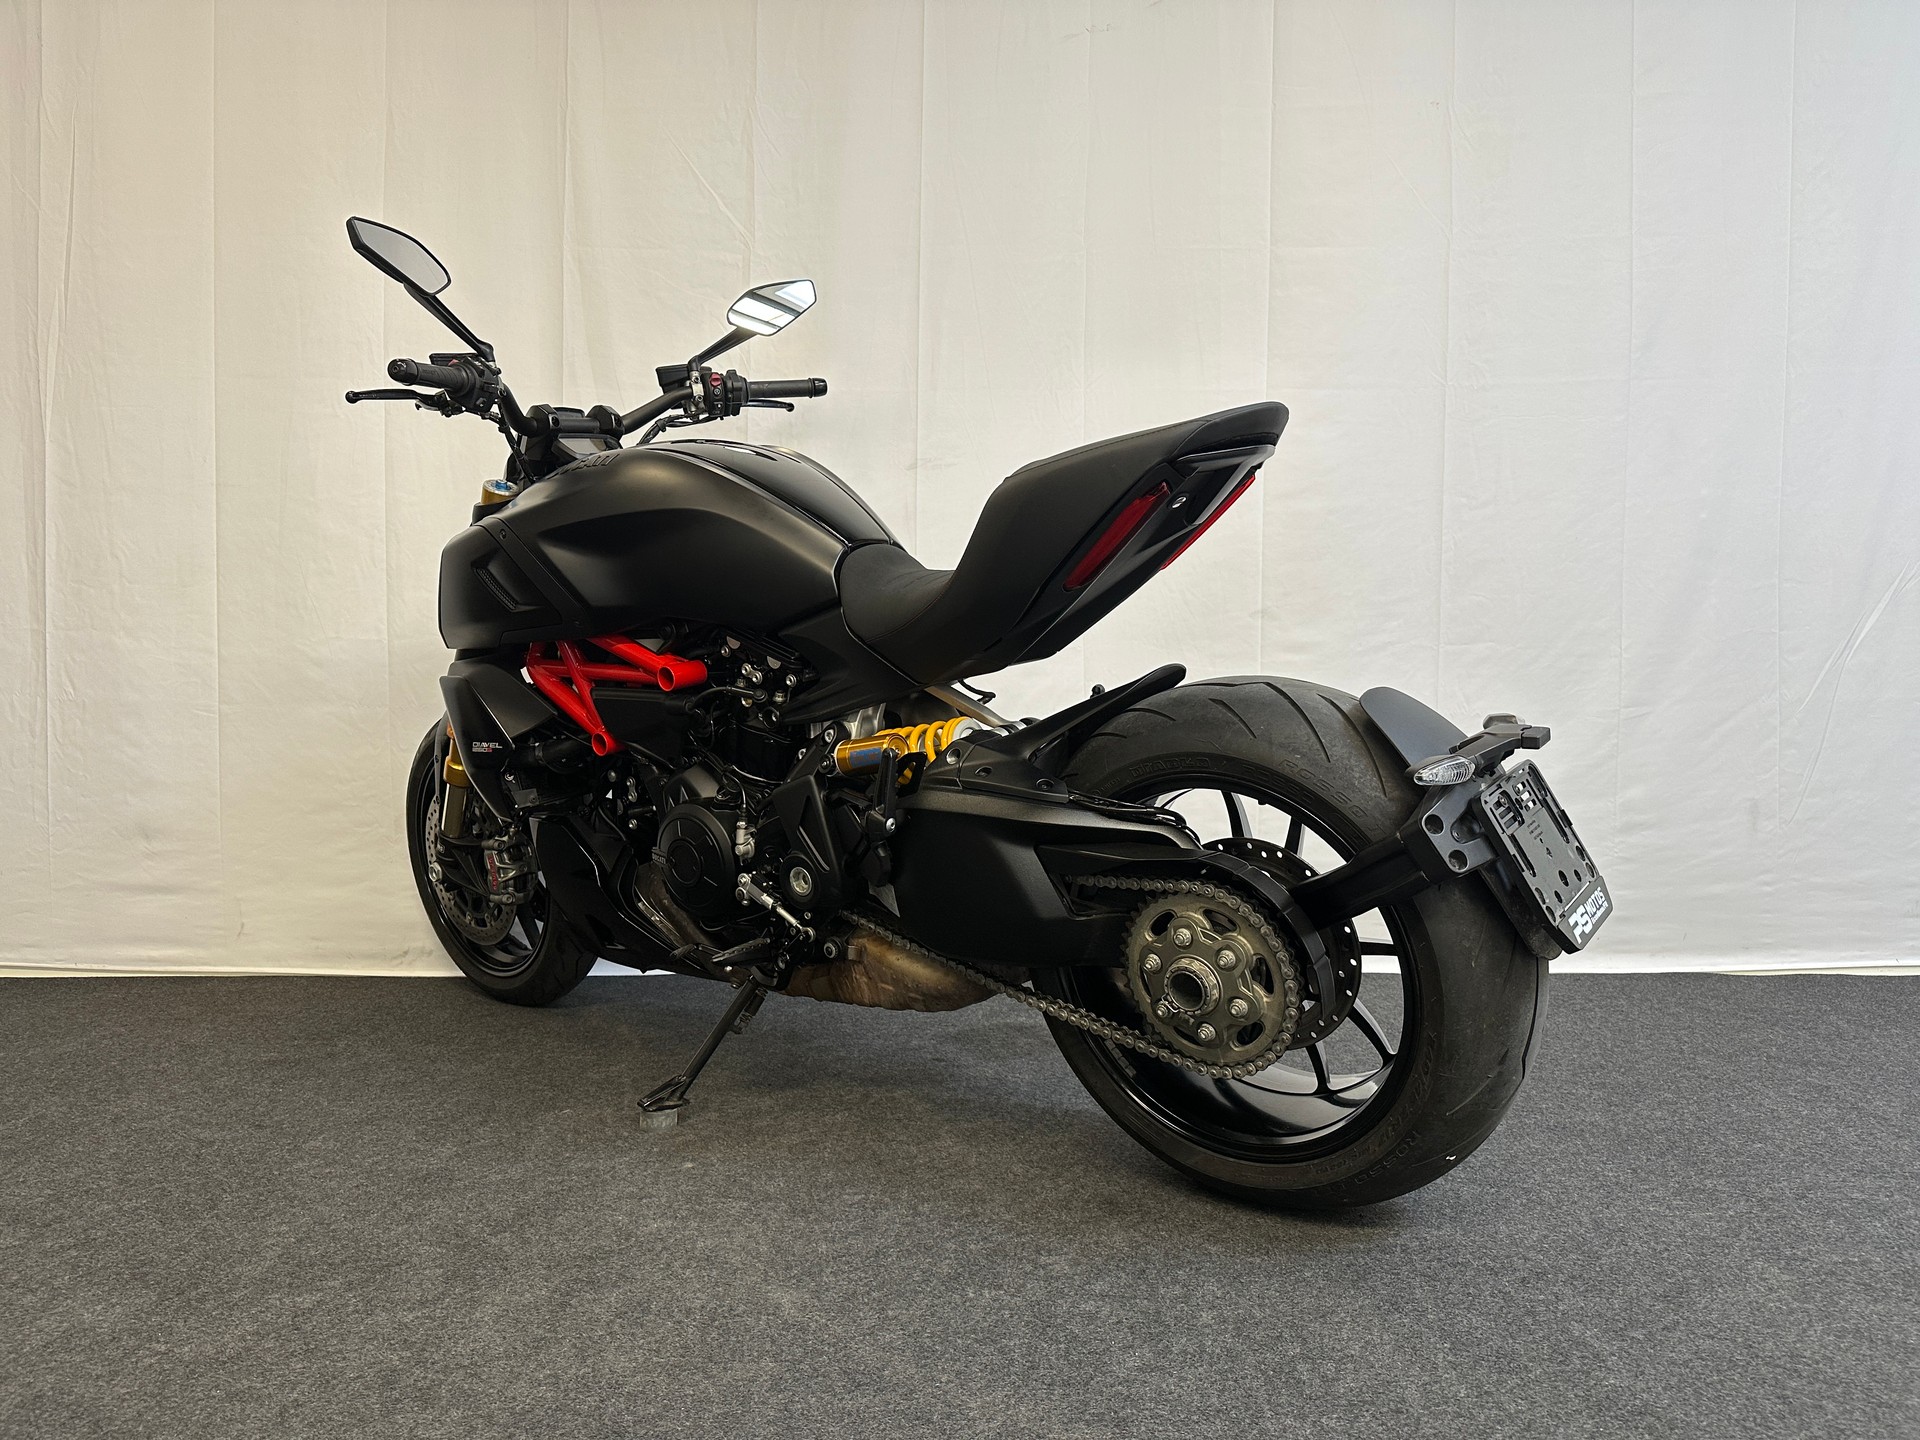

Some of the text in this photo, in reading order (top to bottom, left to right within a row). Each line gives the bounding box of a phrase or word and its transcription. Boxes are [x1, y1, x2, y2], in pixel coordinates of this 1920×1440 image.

[472, 741, 503, 749] DIAVEL
[1129, 757, 1211, 778] DIABLO
[1279, 757, 1369, 821] ROSSO
[1567, 904, 1593, 944] PS
[1583, 886, 1606, 919] MOTOS
